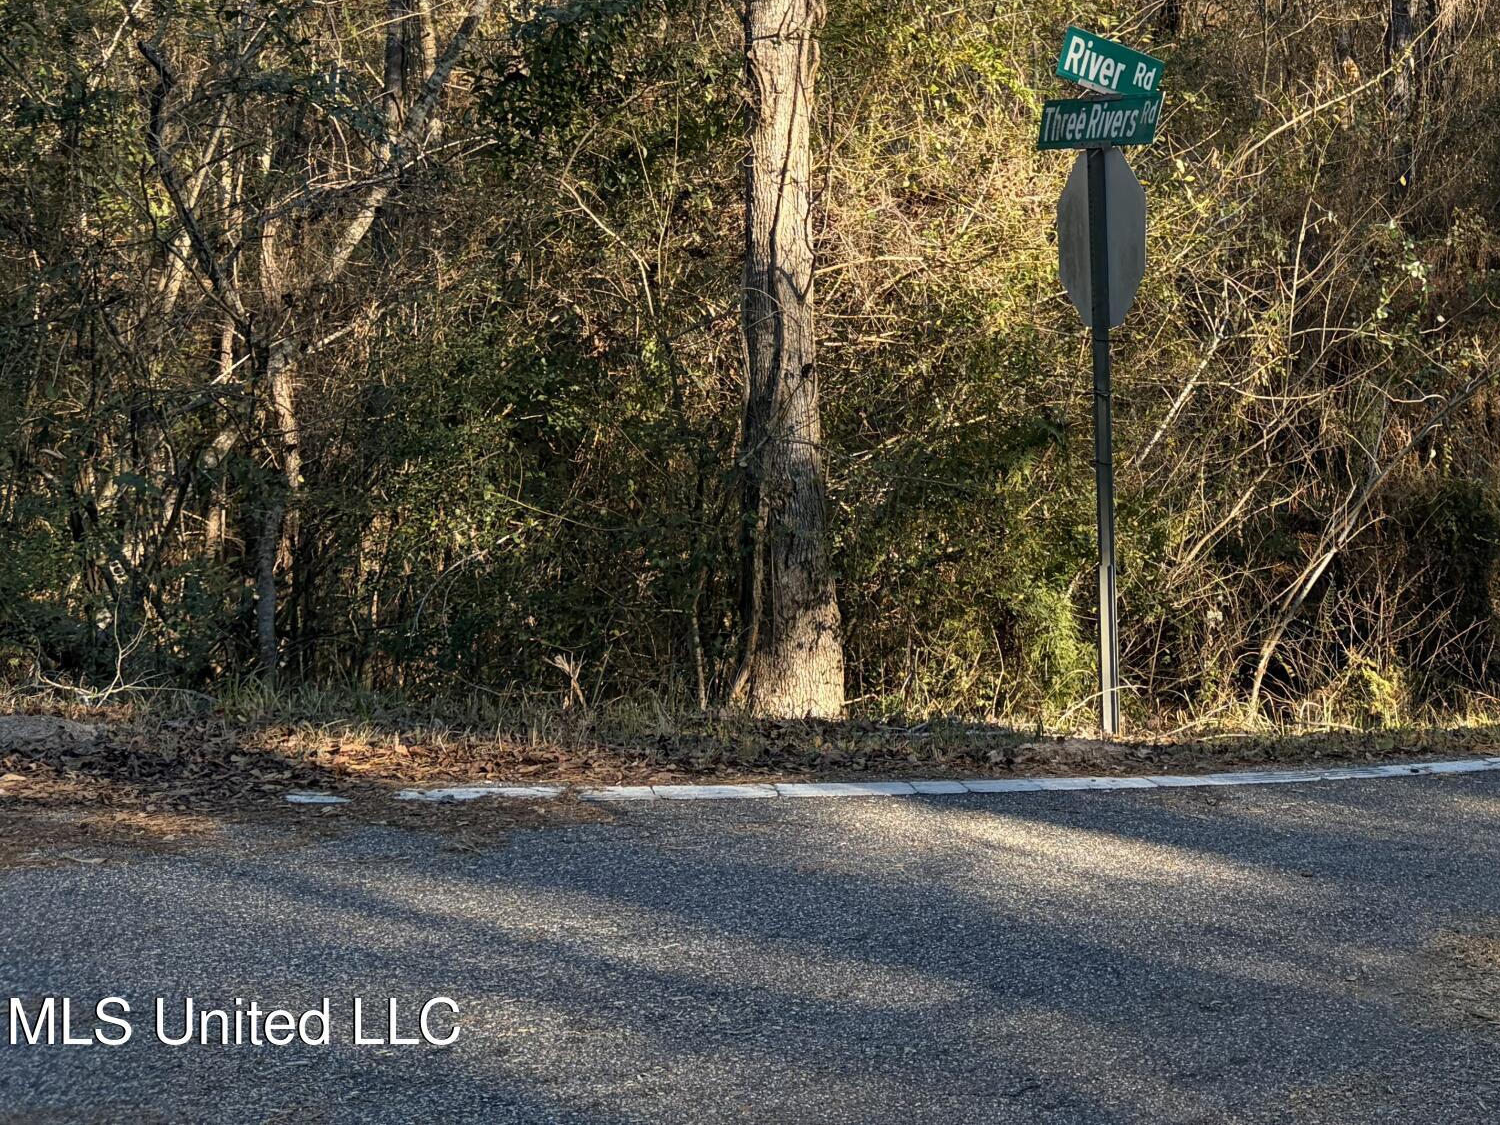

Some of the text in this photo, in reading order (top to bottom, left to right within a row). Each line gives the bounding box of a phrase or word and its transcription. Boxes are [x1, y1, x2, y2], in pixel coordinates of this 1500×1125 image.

[1064, 35, 1156, 91] River Rd
[1044, 100, 1159, 141] Three Rivers Rd
